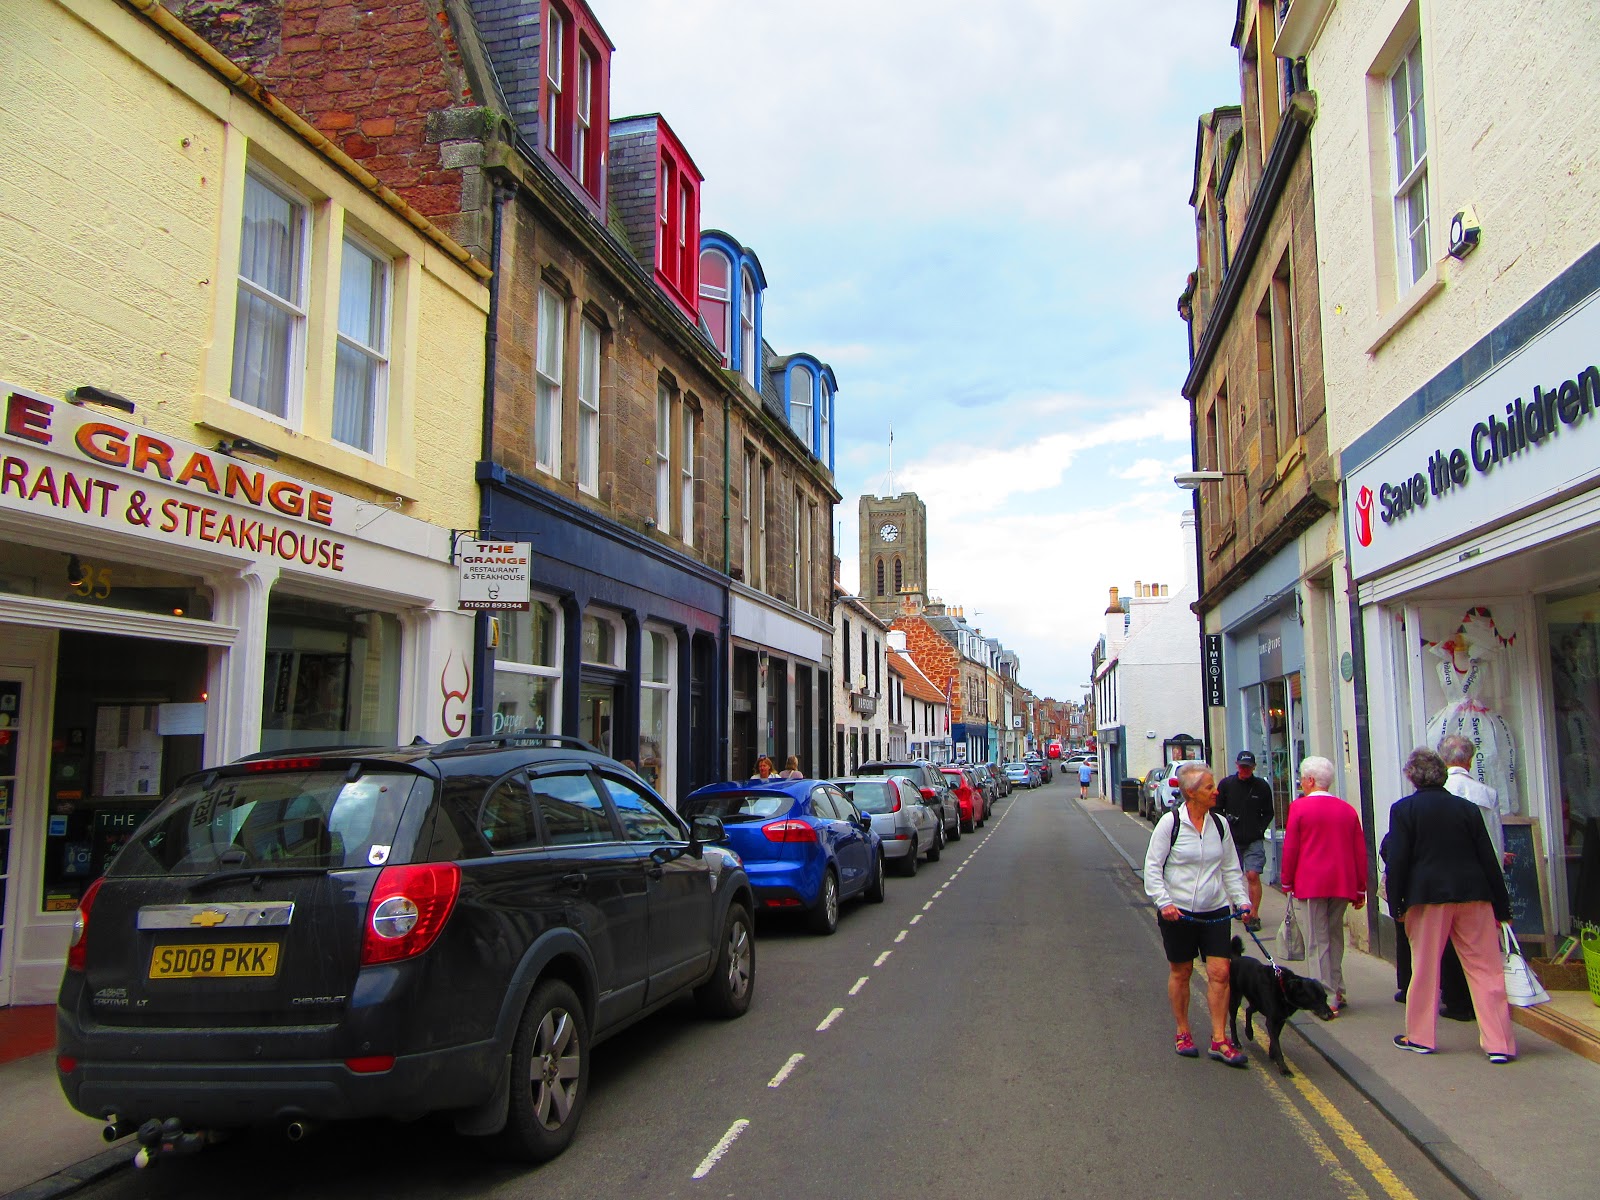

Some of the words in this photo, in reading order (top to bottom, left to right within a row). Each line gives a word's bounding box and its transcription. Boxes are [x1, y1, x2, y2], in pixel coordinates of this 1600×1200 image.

[1379, 472, 1425, 522] Save
[1428, 449, 1467, 496] the
[1470, 365, 1600, 472] Children
[5, 392, 54, 445] E
[75, 422, 334, 526] GRANGE
[126, 490, 152, 527] &
[160, 498, 345, 572] STEAKHOUSE
[476, 545, 514, 553] THE
[1209, 636, 1218, 665] TIME
[1472, 718, 1480, 736] Save
[1475, 752, 1486, 784] Childre
[101, 814, 135, 826] THE
[160, 948, 216, 973] SD08
[220, 947, 269, 972] PKK
[292, 995, 347, 1005] CHEVROLET
